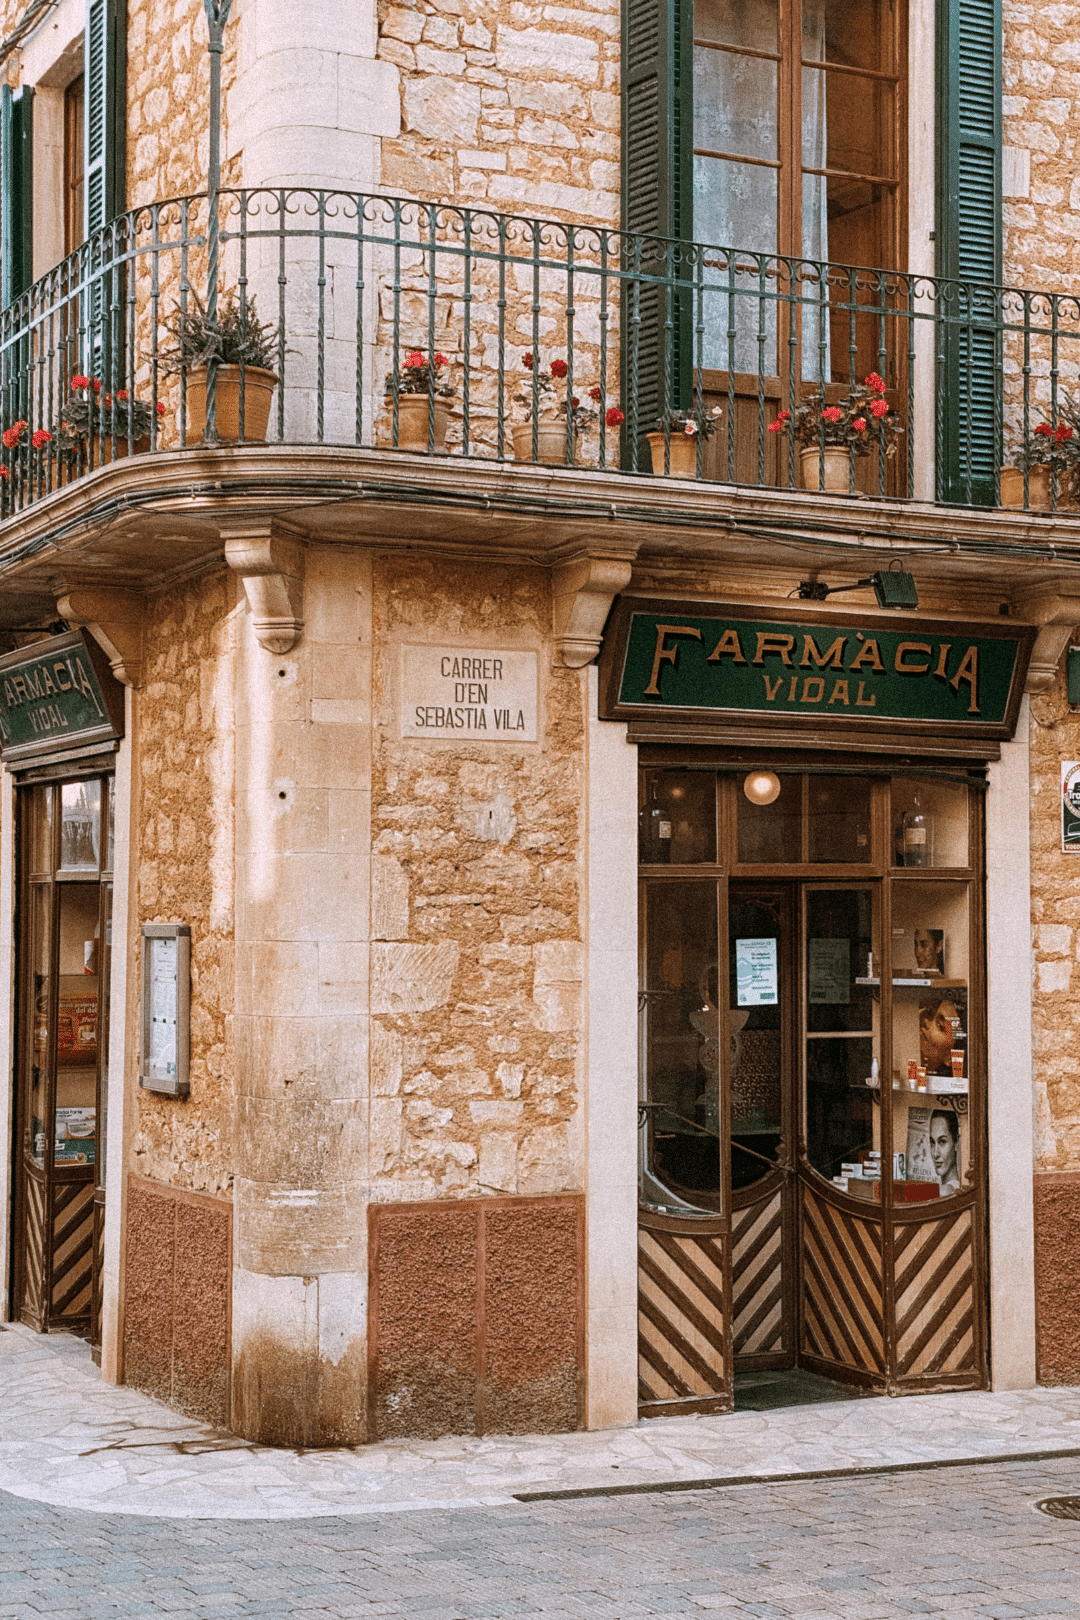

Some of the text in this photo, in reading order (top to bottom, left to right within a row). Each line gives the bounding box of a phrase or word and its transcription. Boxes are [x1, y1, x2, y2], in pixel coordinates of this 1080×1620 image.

[440, 656, 503, 680] CARRER
[643, 624, 981, 714] FARMÀCIA
[0, 657, 105, 739] ARMÀCIA
[454, 682, 488, 704] D'EN
[762, 675, 877, 706] VIDAL
[27, 704, 69, 733] VIDAL
[415, 706, 525, 731] SEBASTIA VILA
